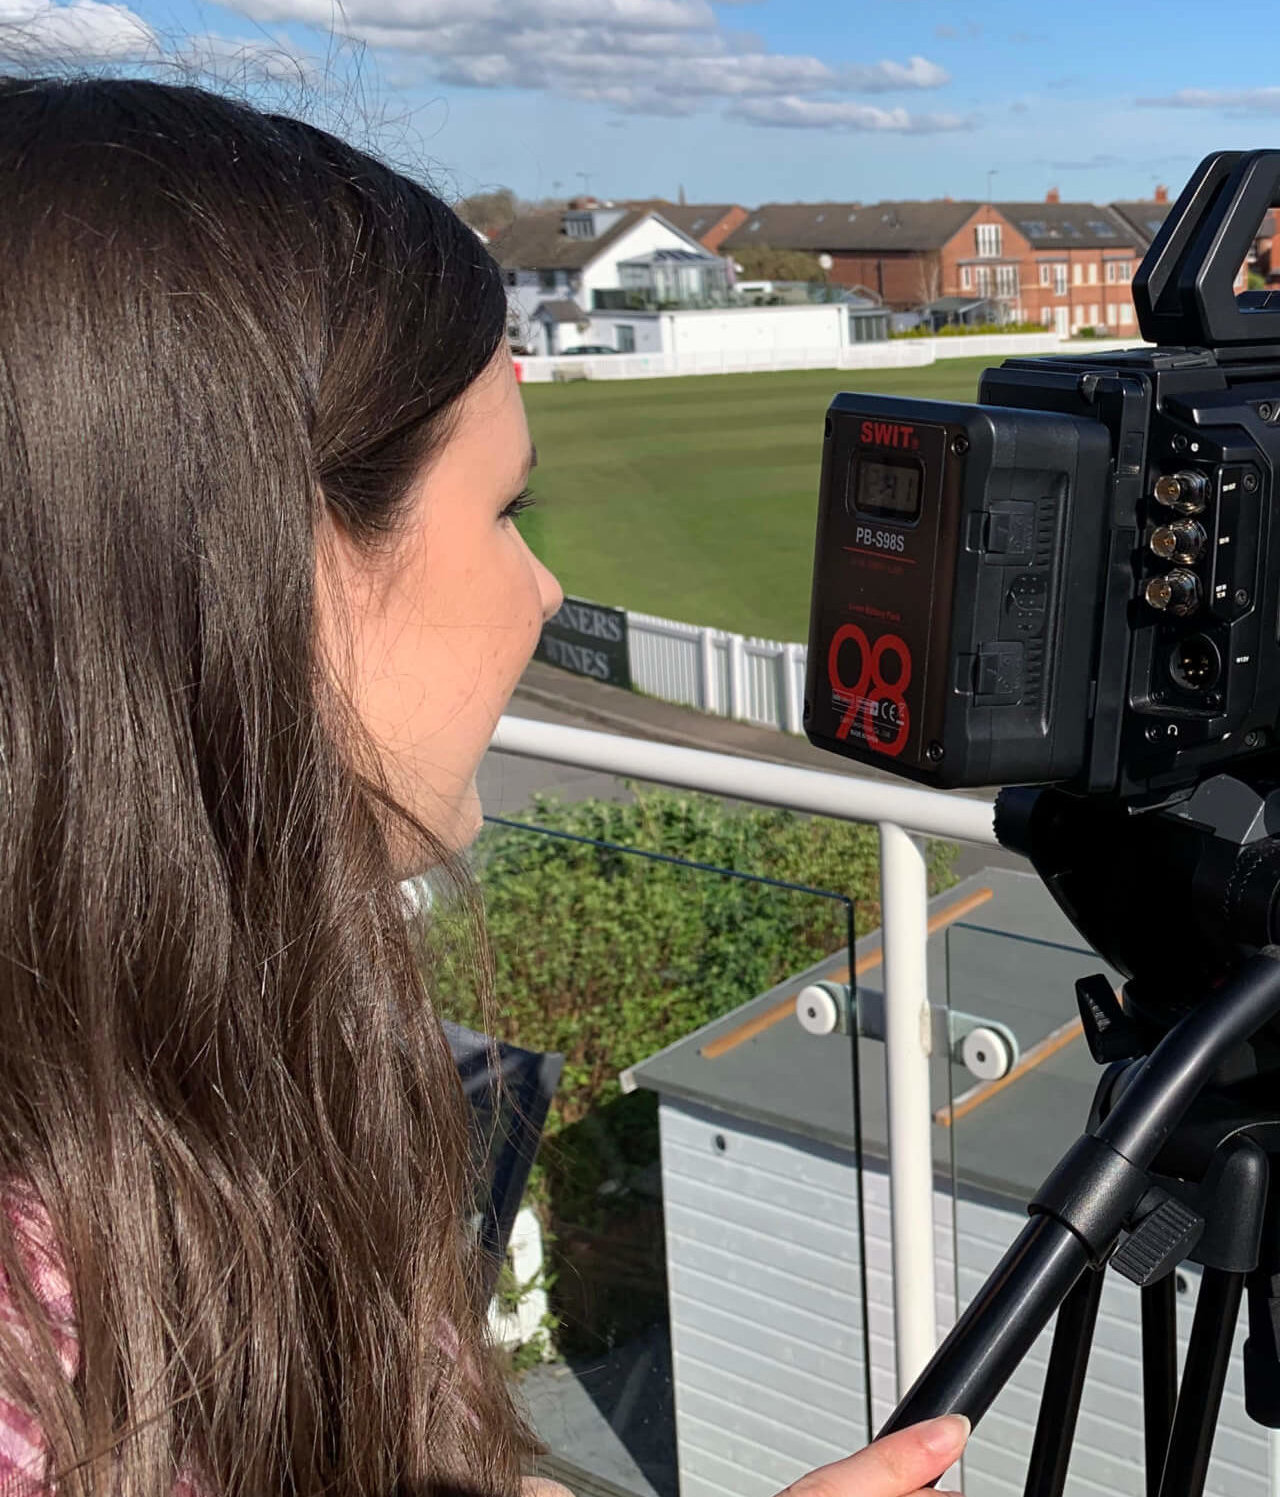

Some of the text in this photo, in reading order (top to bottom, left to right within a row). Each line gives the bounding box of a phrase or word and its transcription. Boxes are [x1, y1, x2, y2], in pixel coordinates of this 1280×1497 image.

[860, 420, 914, 449] SWIT
[855, 526, 905, 553] PB-S98S
[551, 602, 623, 641] NERS
[828, 623, 912, 758] 98
